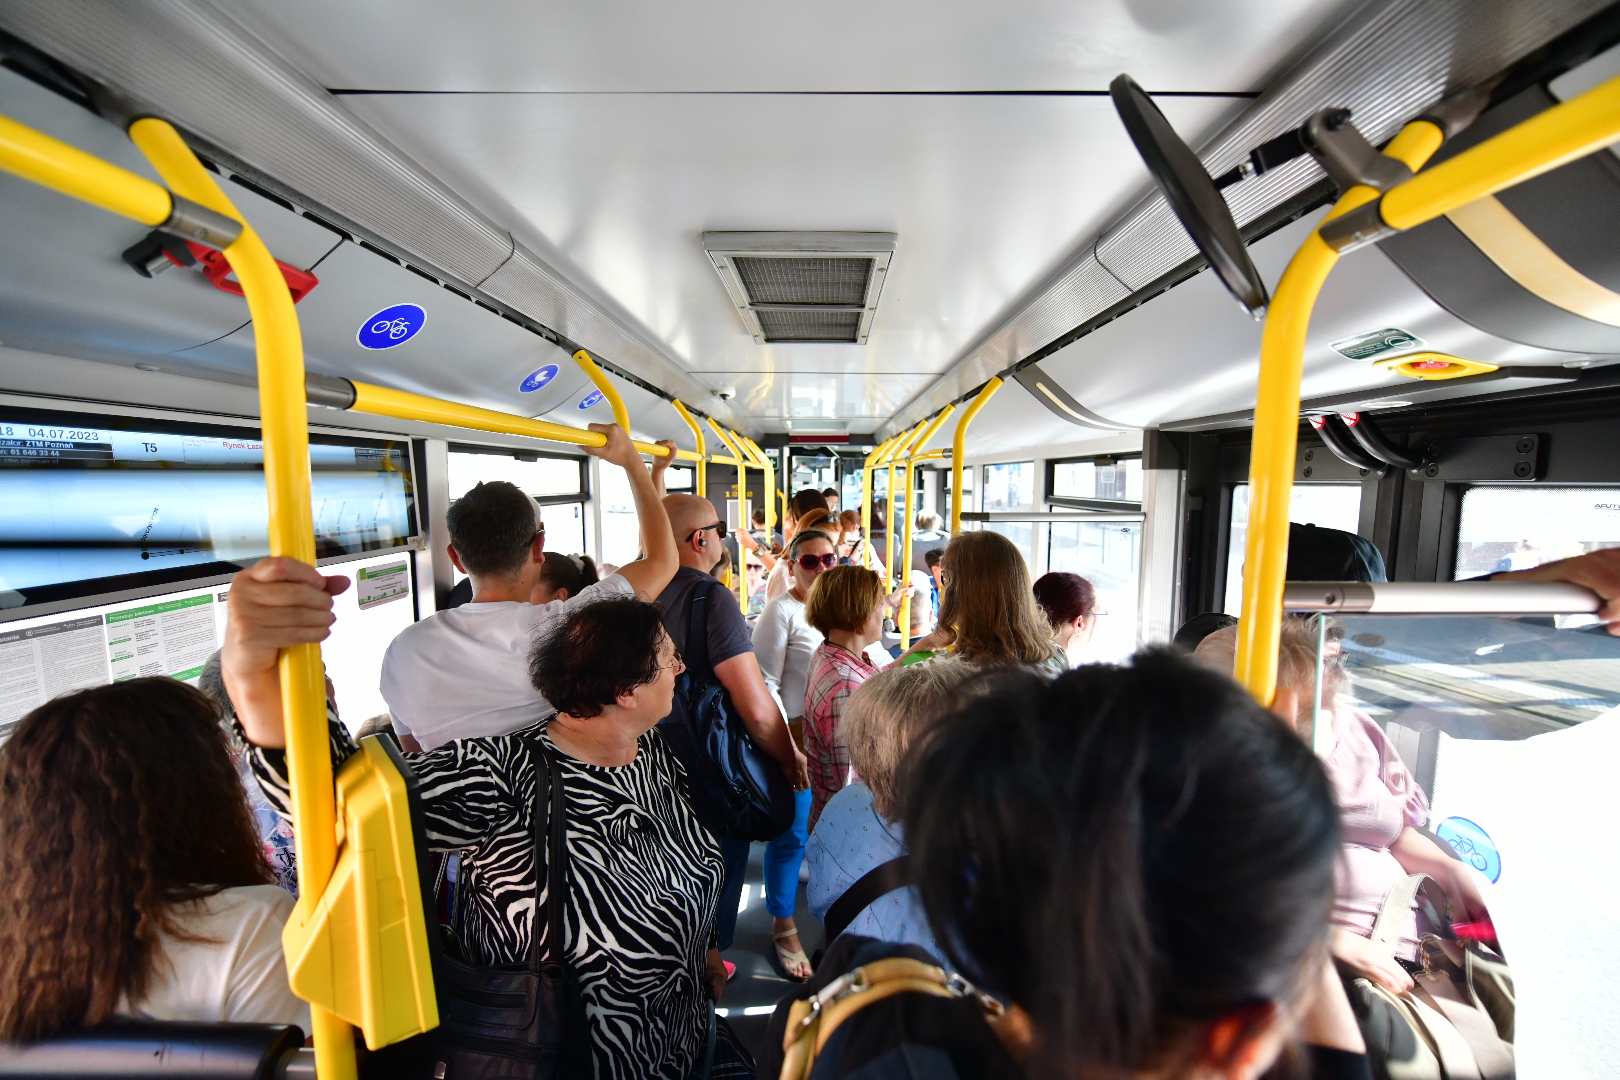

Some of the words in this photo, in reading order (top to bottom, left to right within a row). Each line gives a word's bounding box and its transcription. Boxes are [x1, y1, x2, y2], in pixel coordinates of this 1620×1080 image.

[28, 428, 99, 441] 04.07.2023
[26, 440, 44, 448] ZTM
[45, 441, 74, 449] Poznań
[142, 442, 158, 453] T5
[222, 441, 246, 450] Rynek
